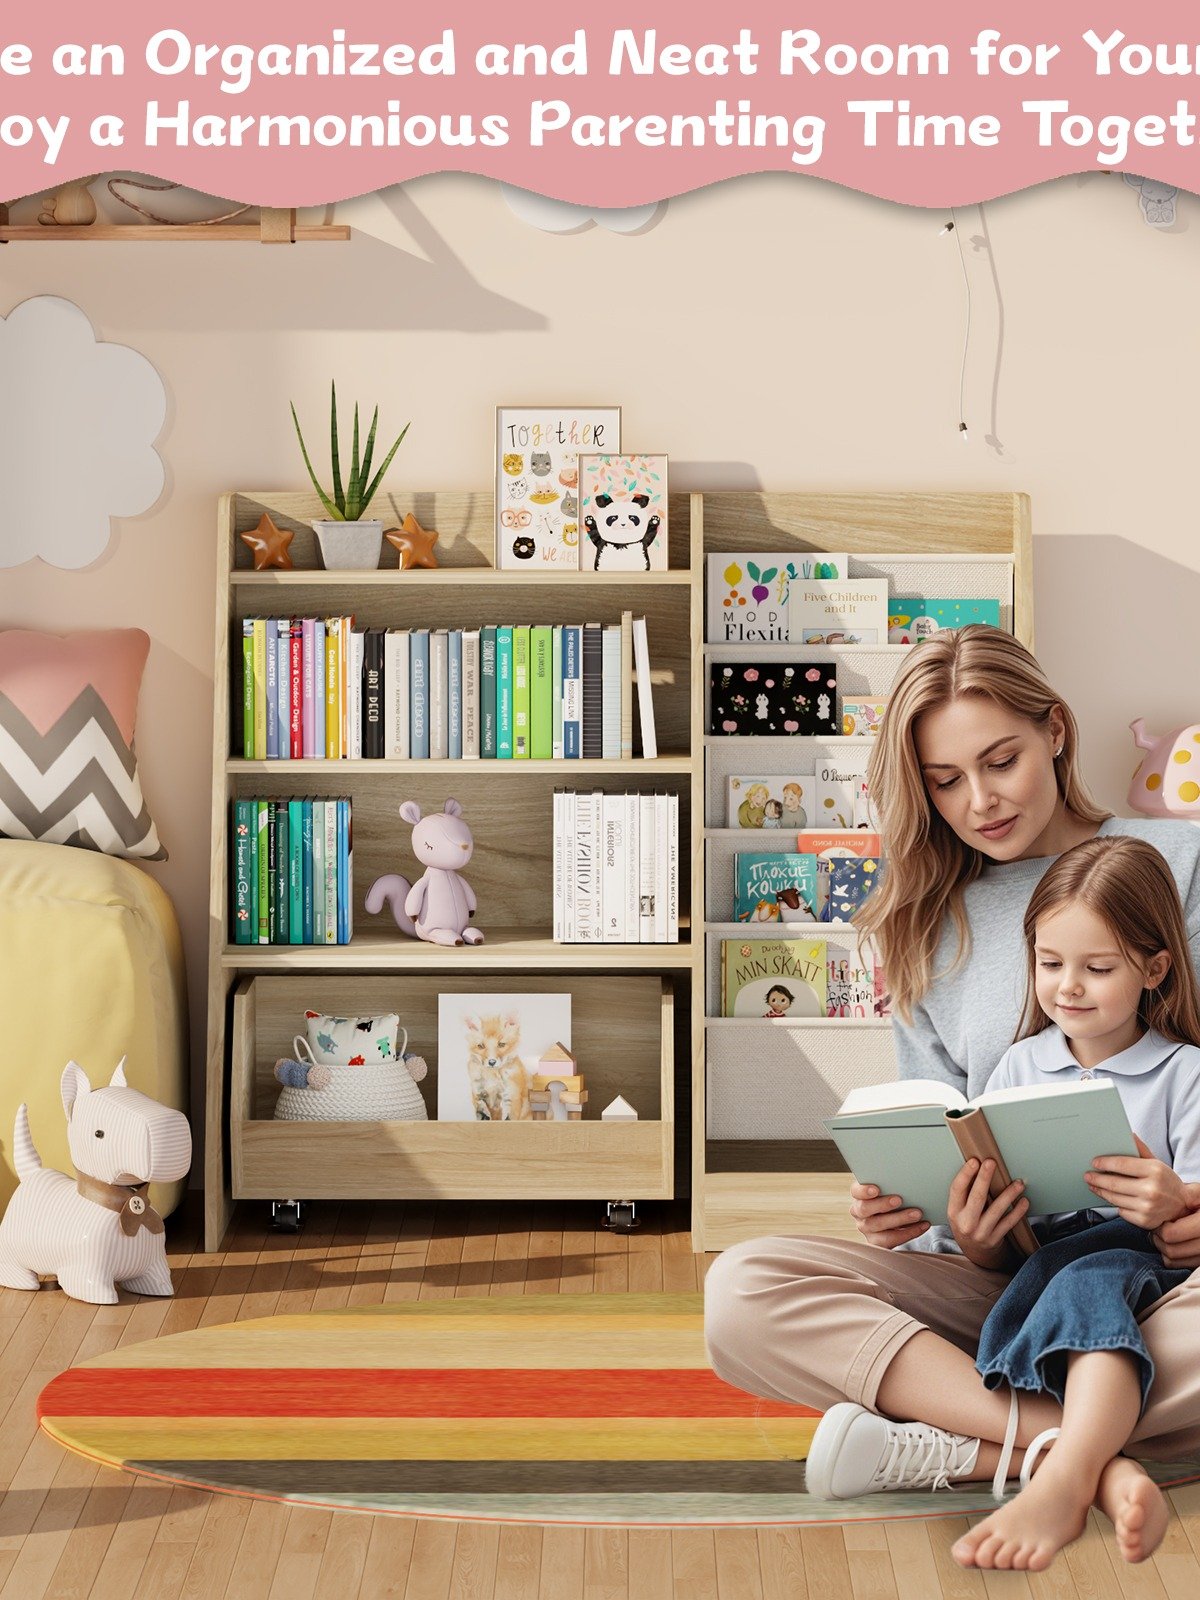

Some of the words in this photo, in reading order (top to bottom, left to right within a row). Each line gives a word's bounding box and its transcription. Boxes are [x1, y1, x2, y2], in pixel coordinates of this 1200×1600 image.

[804, 593, 827, 601] Five
[830, 593, 877, 601] Children
[825, 605, 845, 613] and
[368, 669, 379, 690] ART
[415, 659, 424, 688] art
[279, 680, 287, 709] Design
[368, 697, 378, 722] DECO
[415, 693, 424, 737] deco
[238, 839, 247, 866] Hansel
[238, 881, 248, 907] Gretel
[735, 958, 768, 985] MIN
[772, 956, 822, 981] SKATT
[826, 988, 872, 1011] fashion
